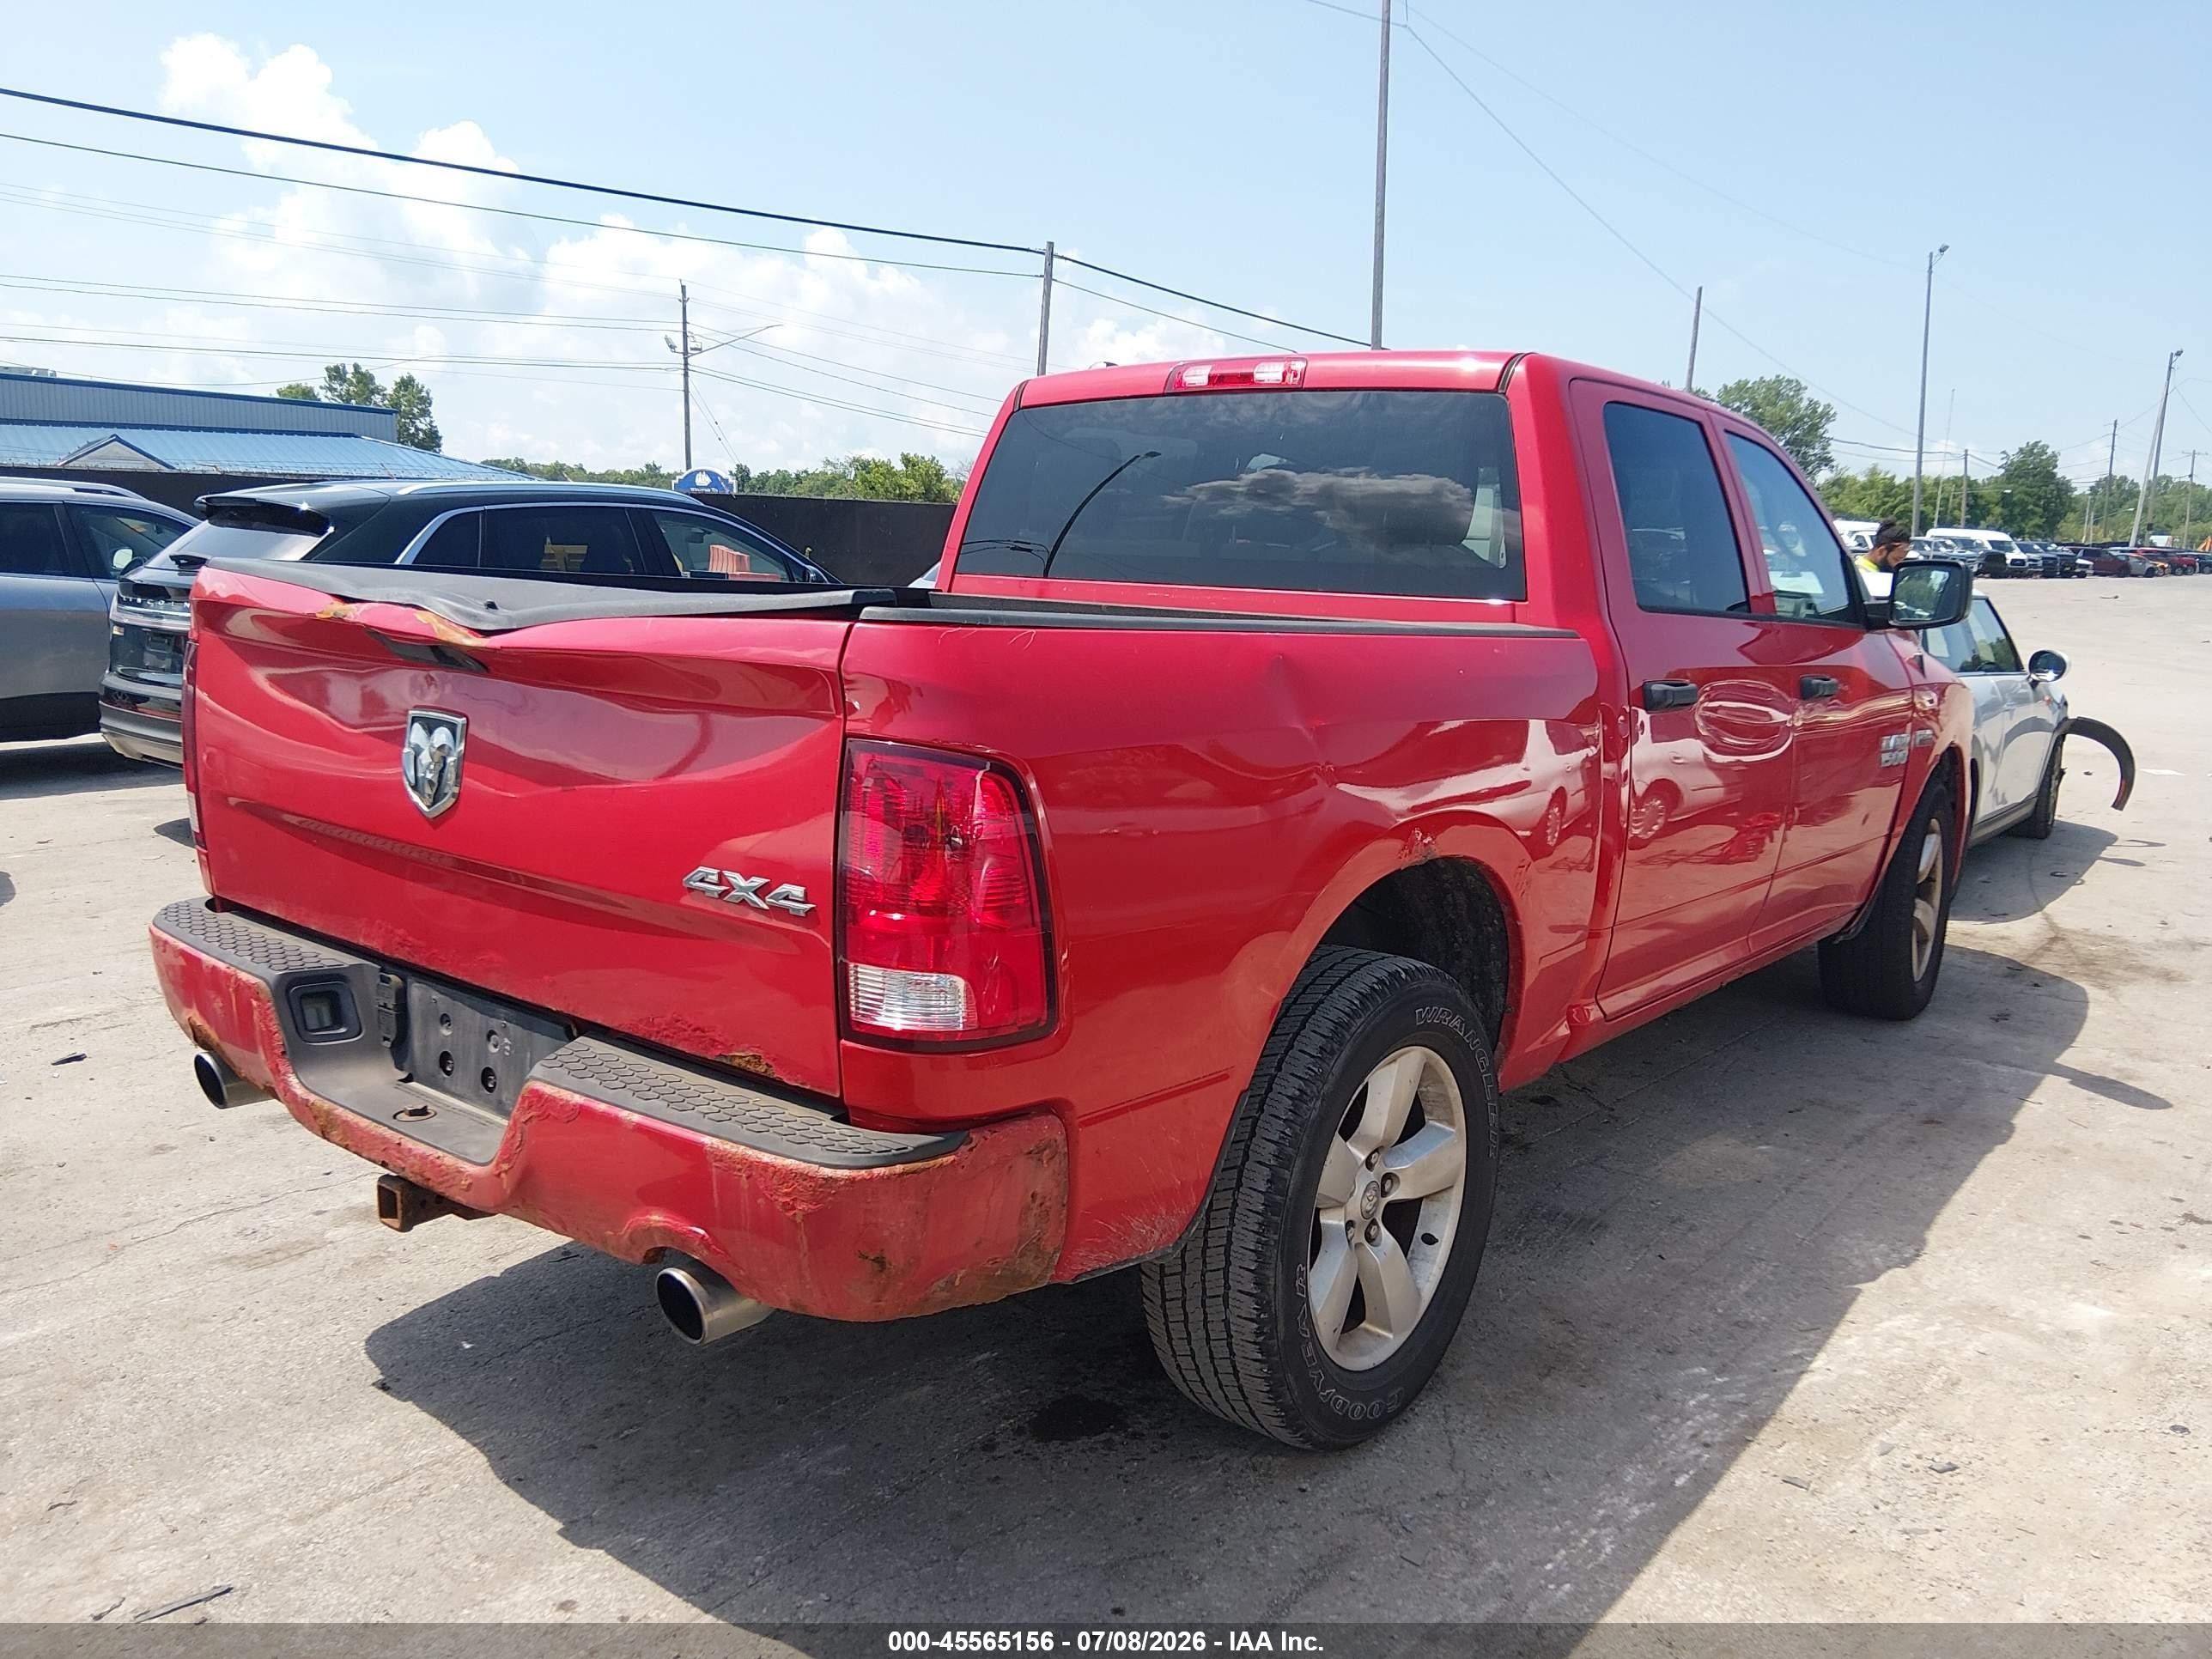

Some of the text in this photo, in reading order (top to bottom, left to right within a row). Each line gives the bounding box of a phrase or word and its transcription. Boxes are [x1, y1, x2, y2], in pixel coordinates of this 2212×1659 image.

[122, 597, 191, 609] LINCOLN
[1415, 1006, 1500, 1159] WRANGLER
[1295, 1263, 1406, 1420] GOODYEAR
